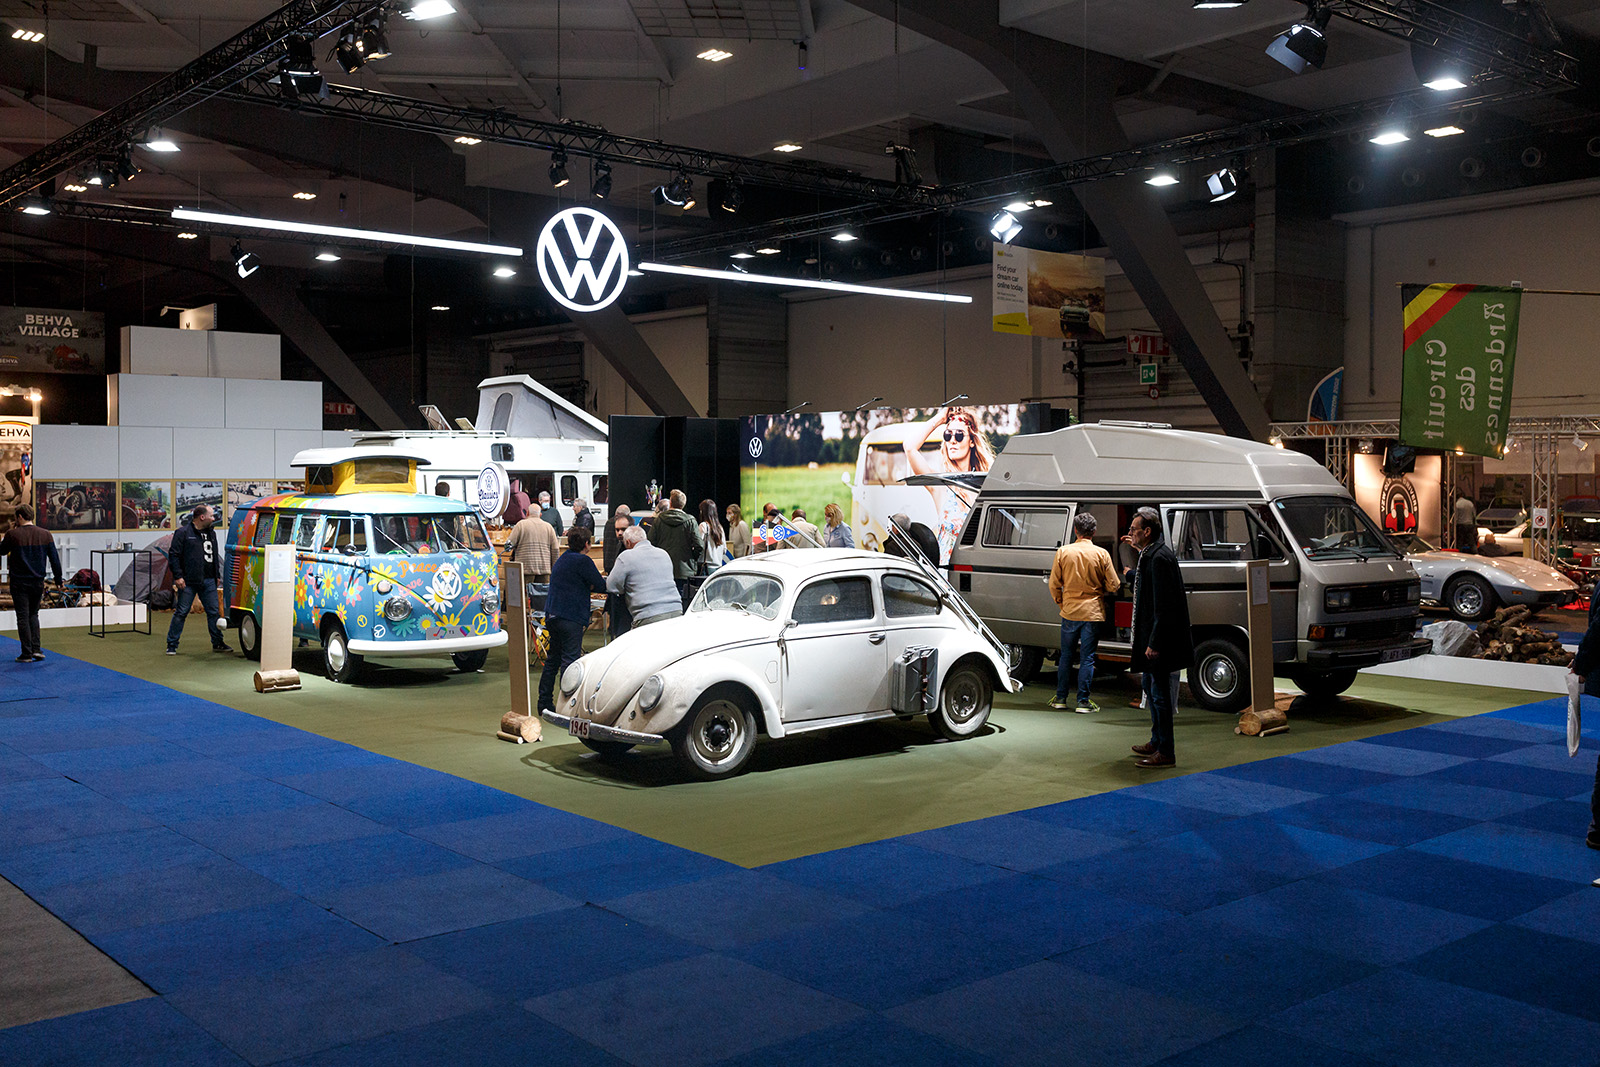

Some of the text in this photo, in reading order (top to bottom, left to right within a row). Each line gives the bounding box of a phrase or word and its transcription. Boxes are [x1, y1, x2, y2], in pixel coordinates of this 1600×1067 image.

[536, 206, 629, 312] VW
[997, 264, 1006, 272] Find
[25, 314, 72, 326] BEHVA
[19, 326, 79, 338] VILLAGE
[397, 560, 439, 578] Peace
[570, 720, 588, 736] 1945
